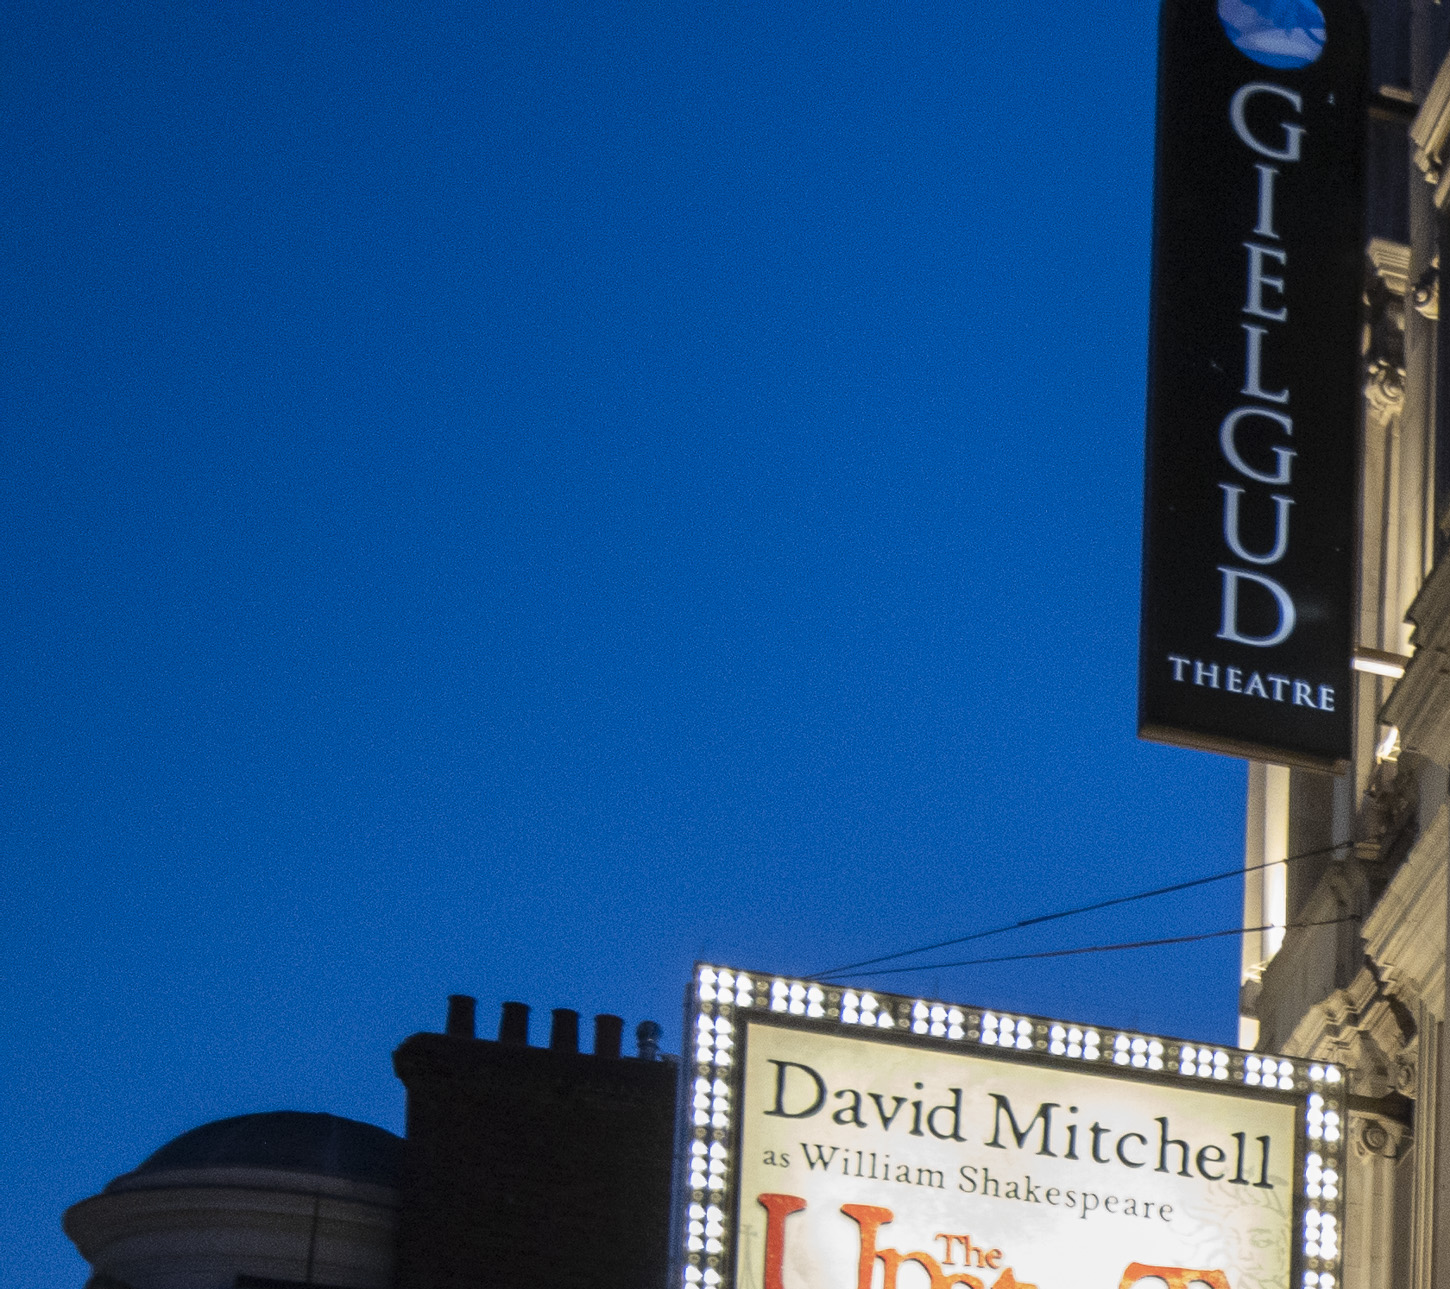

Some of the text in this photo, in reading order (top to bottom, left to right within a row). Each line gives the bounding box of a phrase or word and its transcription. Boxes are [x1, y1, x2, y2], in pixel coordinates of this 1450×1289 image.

[1216, 82, 1307, 648] GIELGUD
[1168, 656, 1336, 713] THEATRE
[763, 1057, 1275, 1190] David Mitchell
[762, 1142, 1174, 1222] as William Shakespeare
[935, 1233, 1003, 1270] The
